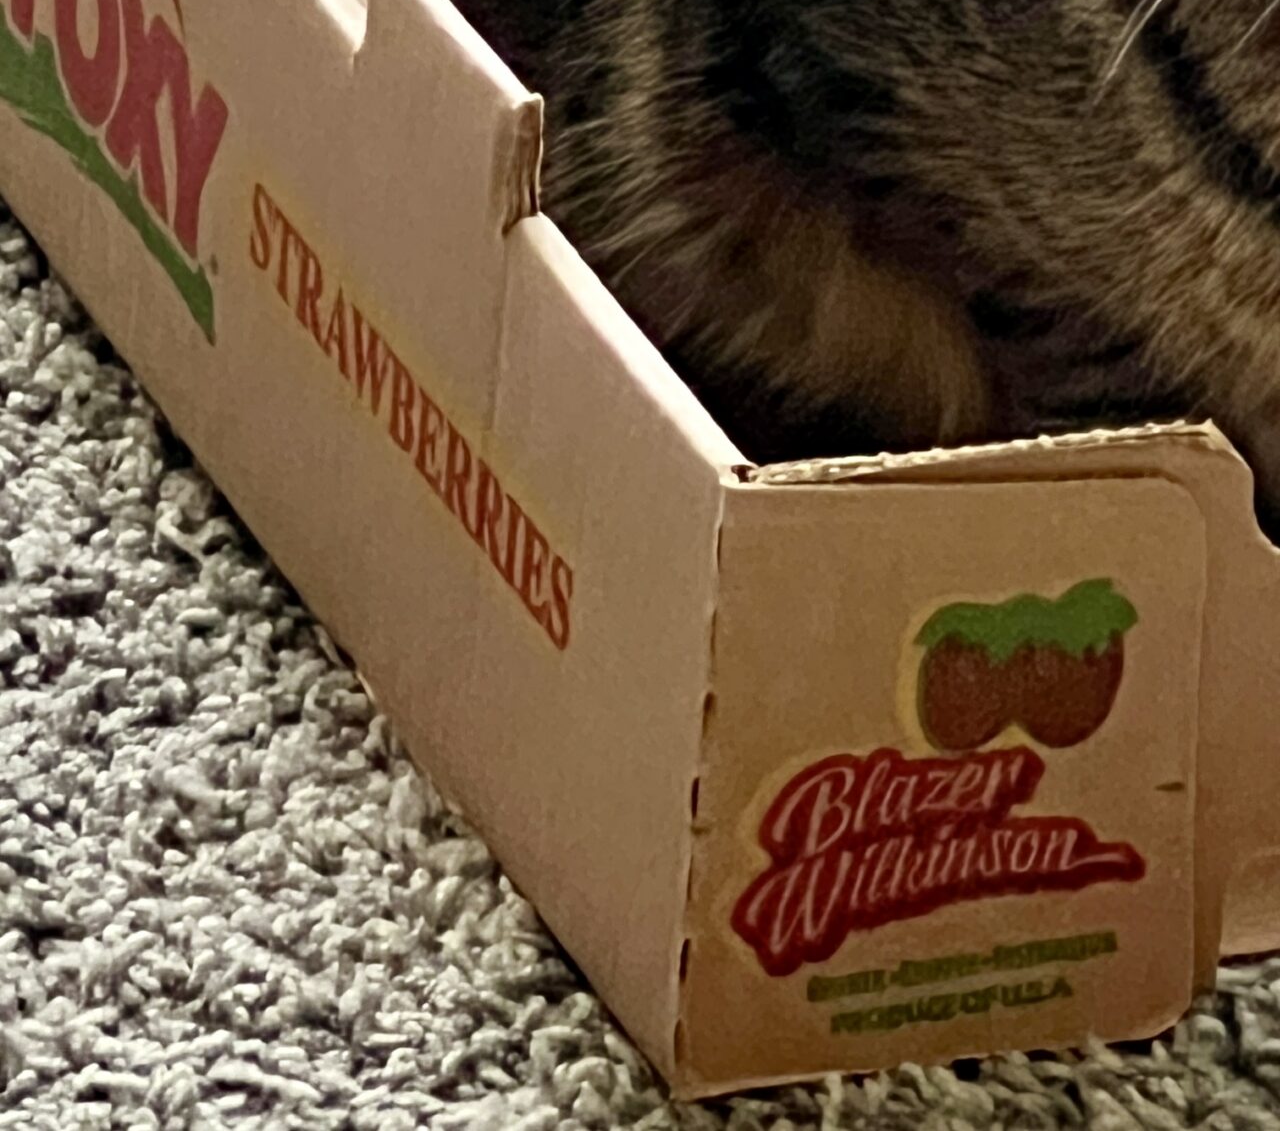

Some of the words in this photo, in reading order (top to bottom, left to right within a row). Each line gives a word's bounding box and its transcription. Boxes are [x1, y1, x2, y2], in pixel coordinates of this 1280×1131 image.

[249, 182, 575, 652] STRAWBERRIES
[770, 753, 1028, 860] Blazer
[745, 823, 1136, 956] Wilkinson
